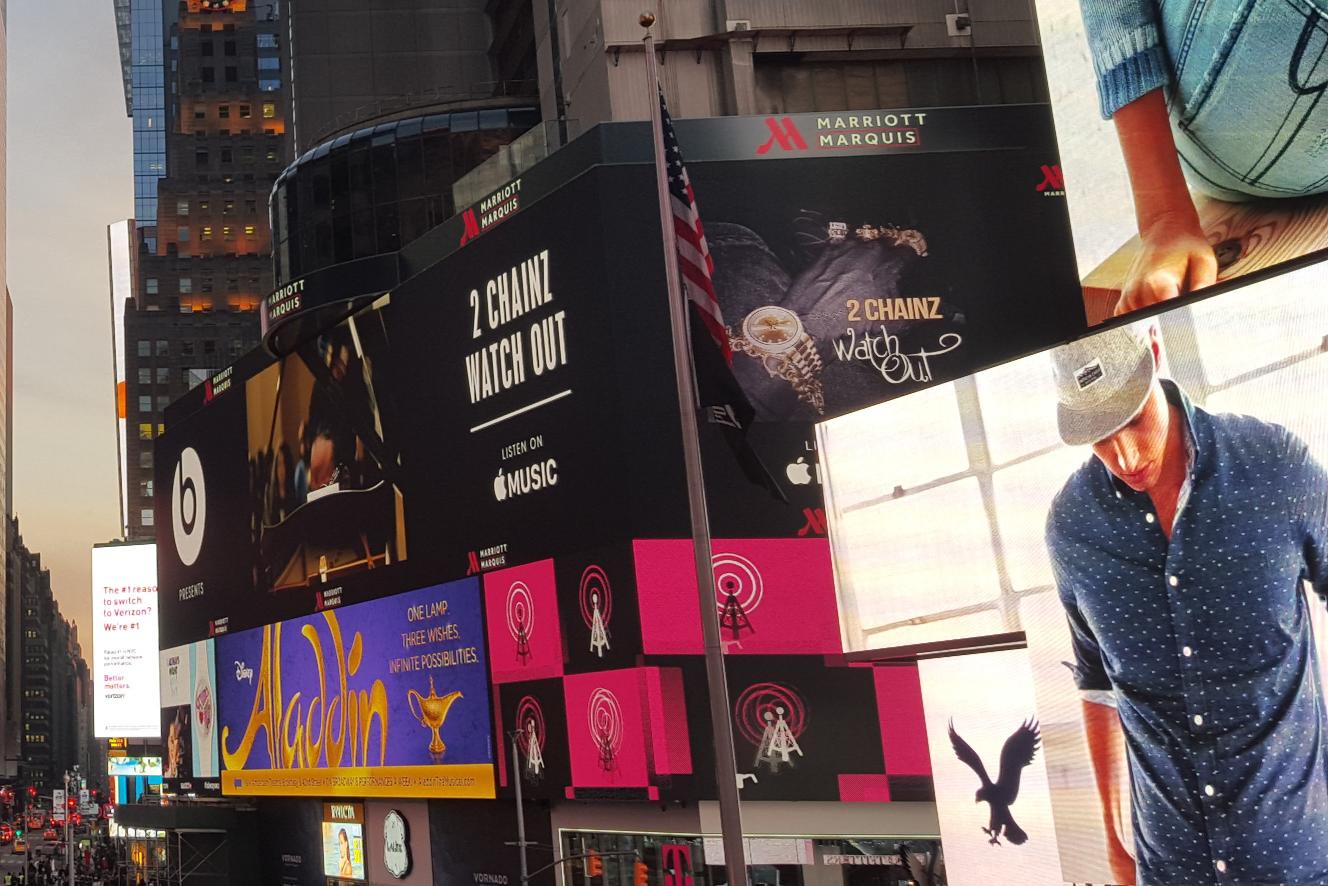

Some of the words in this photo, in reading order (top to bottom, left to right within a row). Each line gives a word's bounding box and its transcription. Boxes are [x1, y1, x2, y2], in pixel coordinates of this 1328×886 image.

[816, 112, 928, 130] MARRIOTT
[818, 130, 918, 147] MARQUIS
[480, 179, 522, 213] MARRIOTT
[481, 198, 518, 228] MARQUIS
[469, 289, 481, 339] 2
[486, 249, 553, 330] CHAINZ
[846, 299, 861, 321] 2
[864, 297, 944, 320] CHAINZ
[465, 331, 525, 404] WATCH
[530, 310, 567, 376] OUT
[501, 441, 527, 460] LISTEN
[529, 434, 543, 451] ON
[507, 458, 558, 498] MUSIC
[479, 543, 508, 558] MARRIOTT
[480, 556, 506, 569] MARQUIS
[103, 586, 119, 594] The
[178, 582, 205, 601] PRESENTS
[103, 598, 112, 606] to
[113, 596, 143, 606] switch
[103, 609, 112, 617] to
[113, 606, 152, 617] Verizon?
[407, 604, 425, 623] ONE
[103, 623, 128, 632] We're
[401, 629, 426, 649] THREE
[427, 623, 461, 643] WISHES.
[235, 660, 254, 684] Disney
[389, 655, 421, 674] INFINITE
[222, 610, 389, 771] Aladdin
[473, 872, 508, 885] VORNADO
